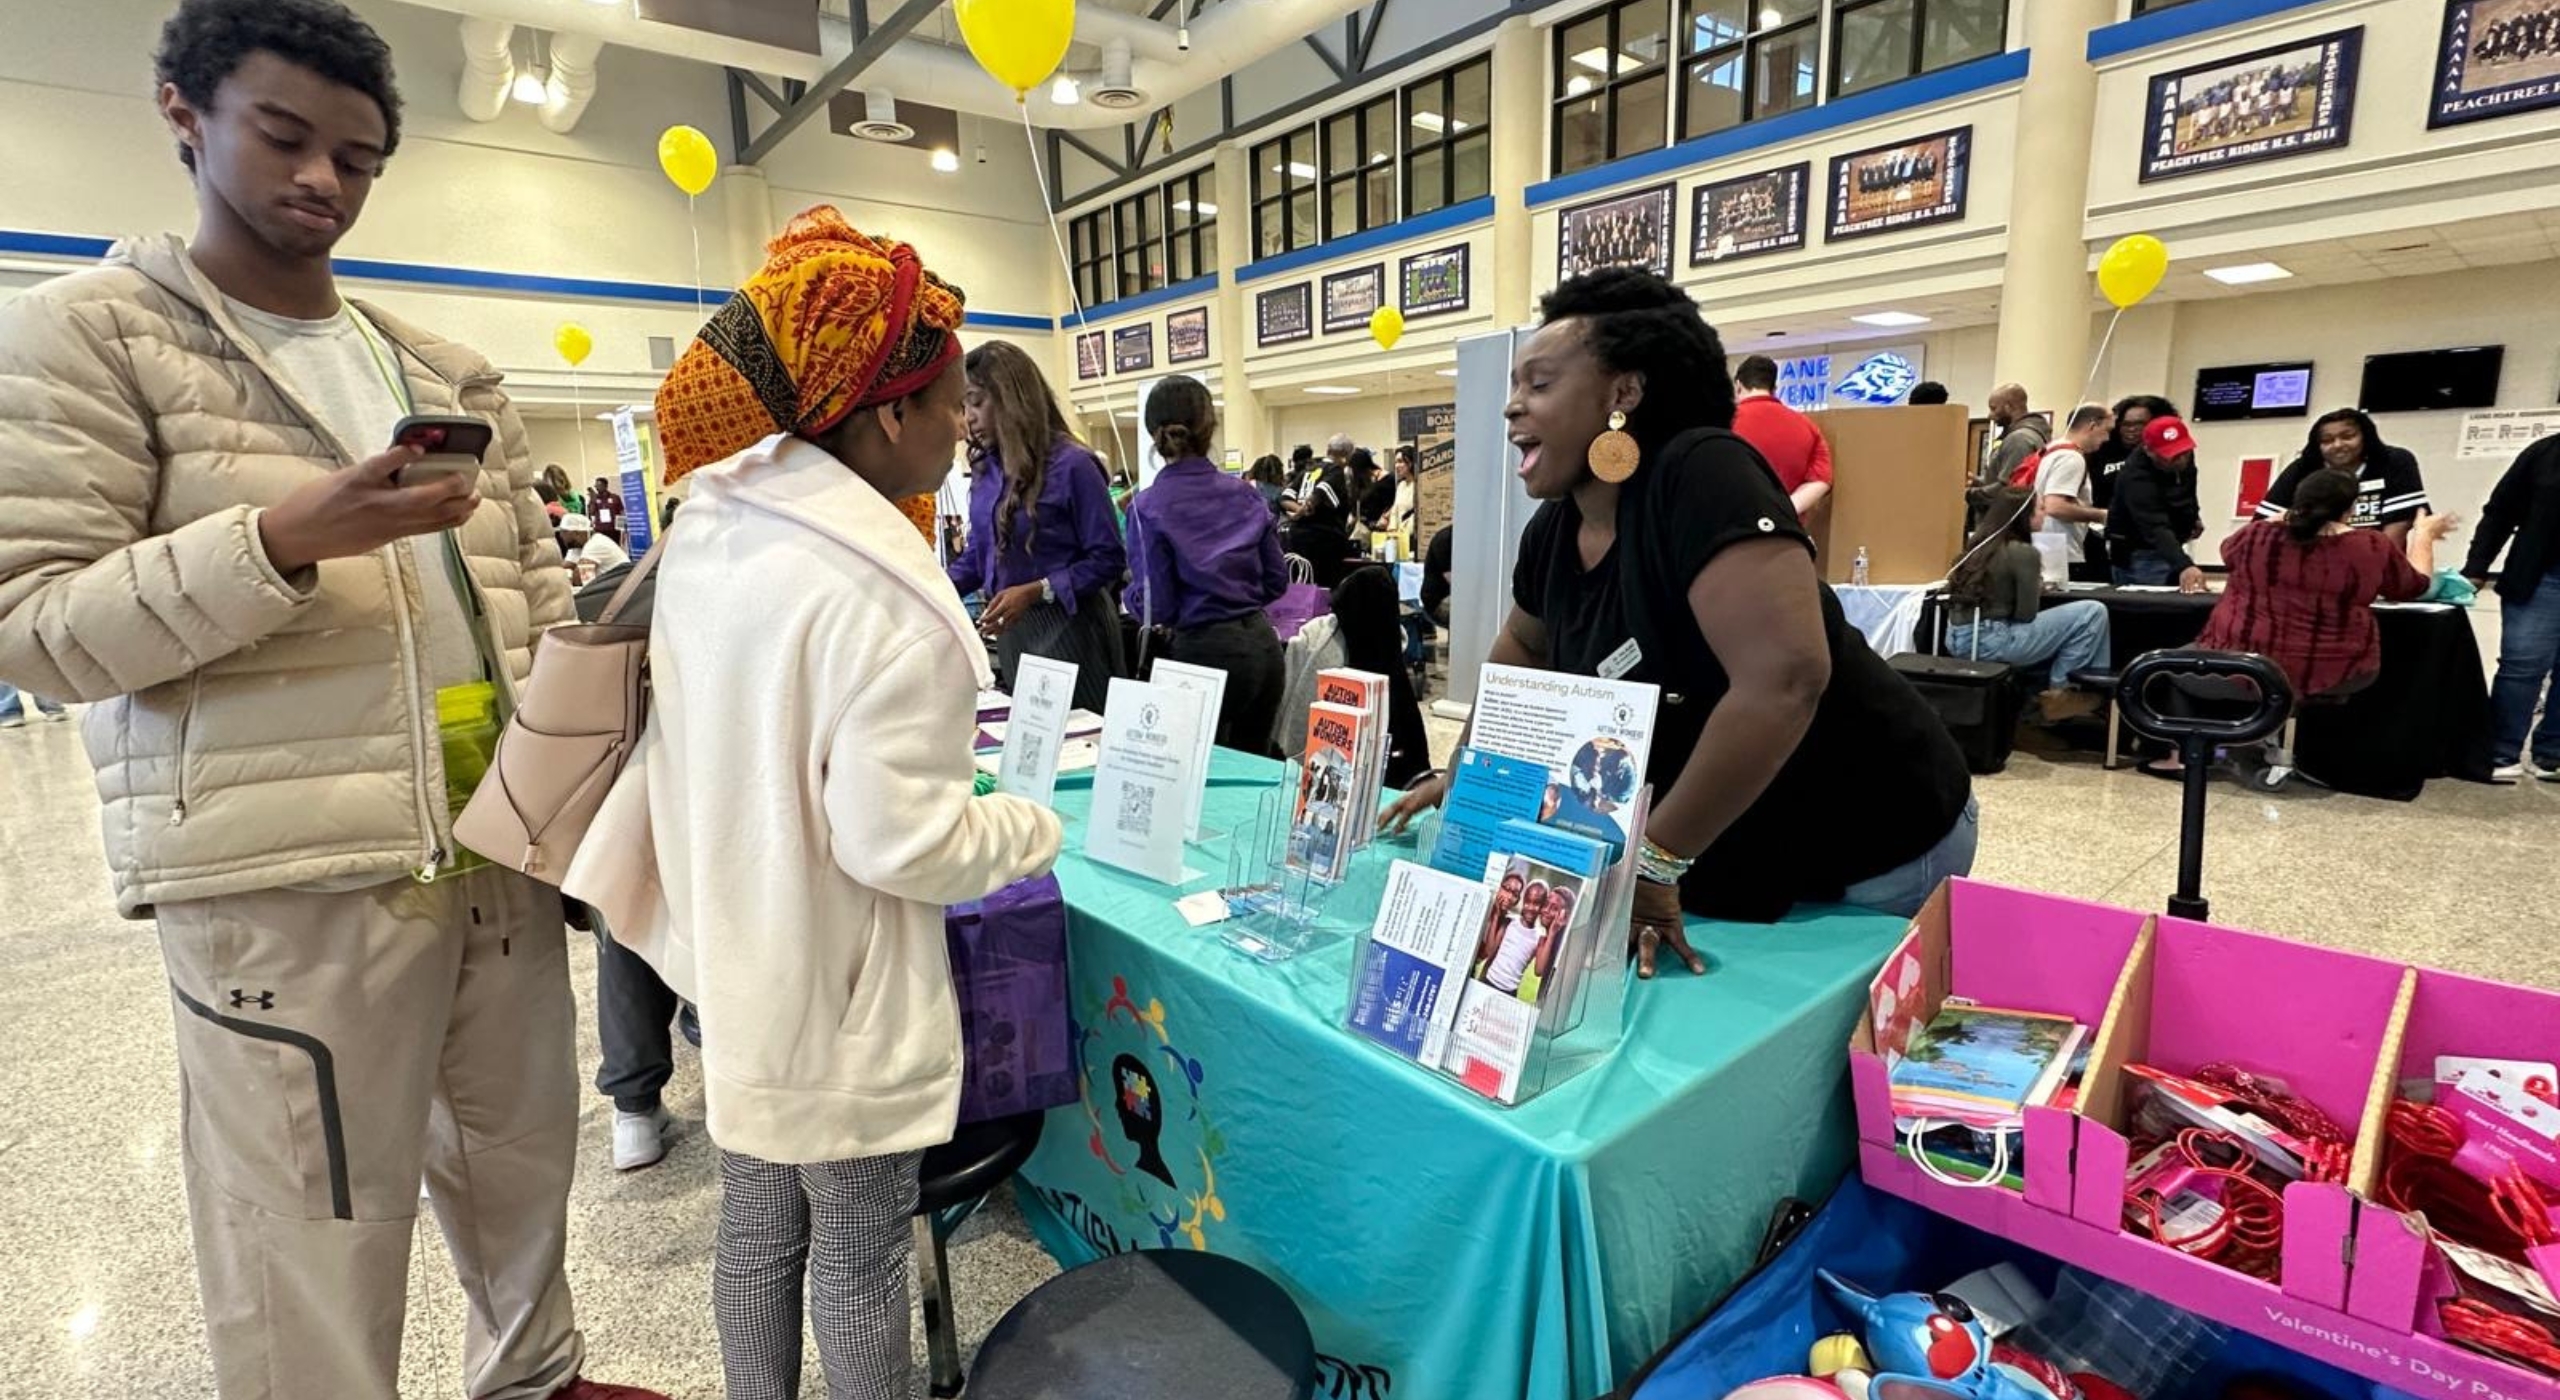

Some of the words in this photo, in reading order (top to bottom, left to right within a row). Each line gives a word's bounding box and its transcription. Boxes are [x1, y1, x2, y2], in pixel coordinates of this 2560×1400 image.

[2442, 82, 2551, 114] PEACHTREE
[2150, 149, 2225, 172] PEACHTREE
[2228, 139, 2269, 157] RIDGE
[2272, 134, 2299, 149] H.S.
[2303, 127, 2337, 143] 2011
[1832, 218, 1884, 235] PEACHTREE
[1780, 357, 1830, 380] ANE
[1326, 683, 1359, 703] AUTISM
[1485, 672, 1568, 698] Understanding
[1571, 683, 1615, 701] Autism
[1318, 716, 1350, 737] AUTISM
[1313, 727, 1354, 752] WONDERS
[2264, 1306, 2401, 1367] Valentine's
[2409, 1358, 2463, 1391] Day
